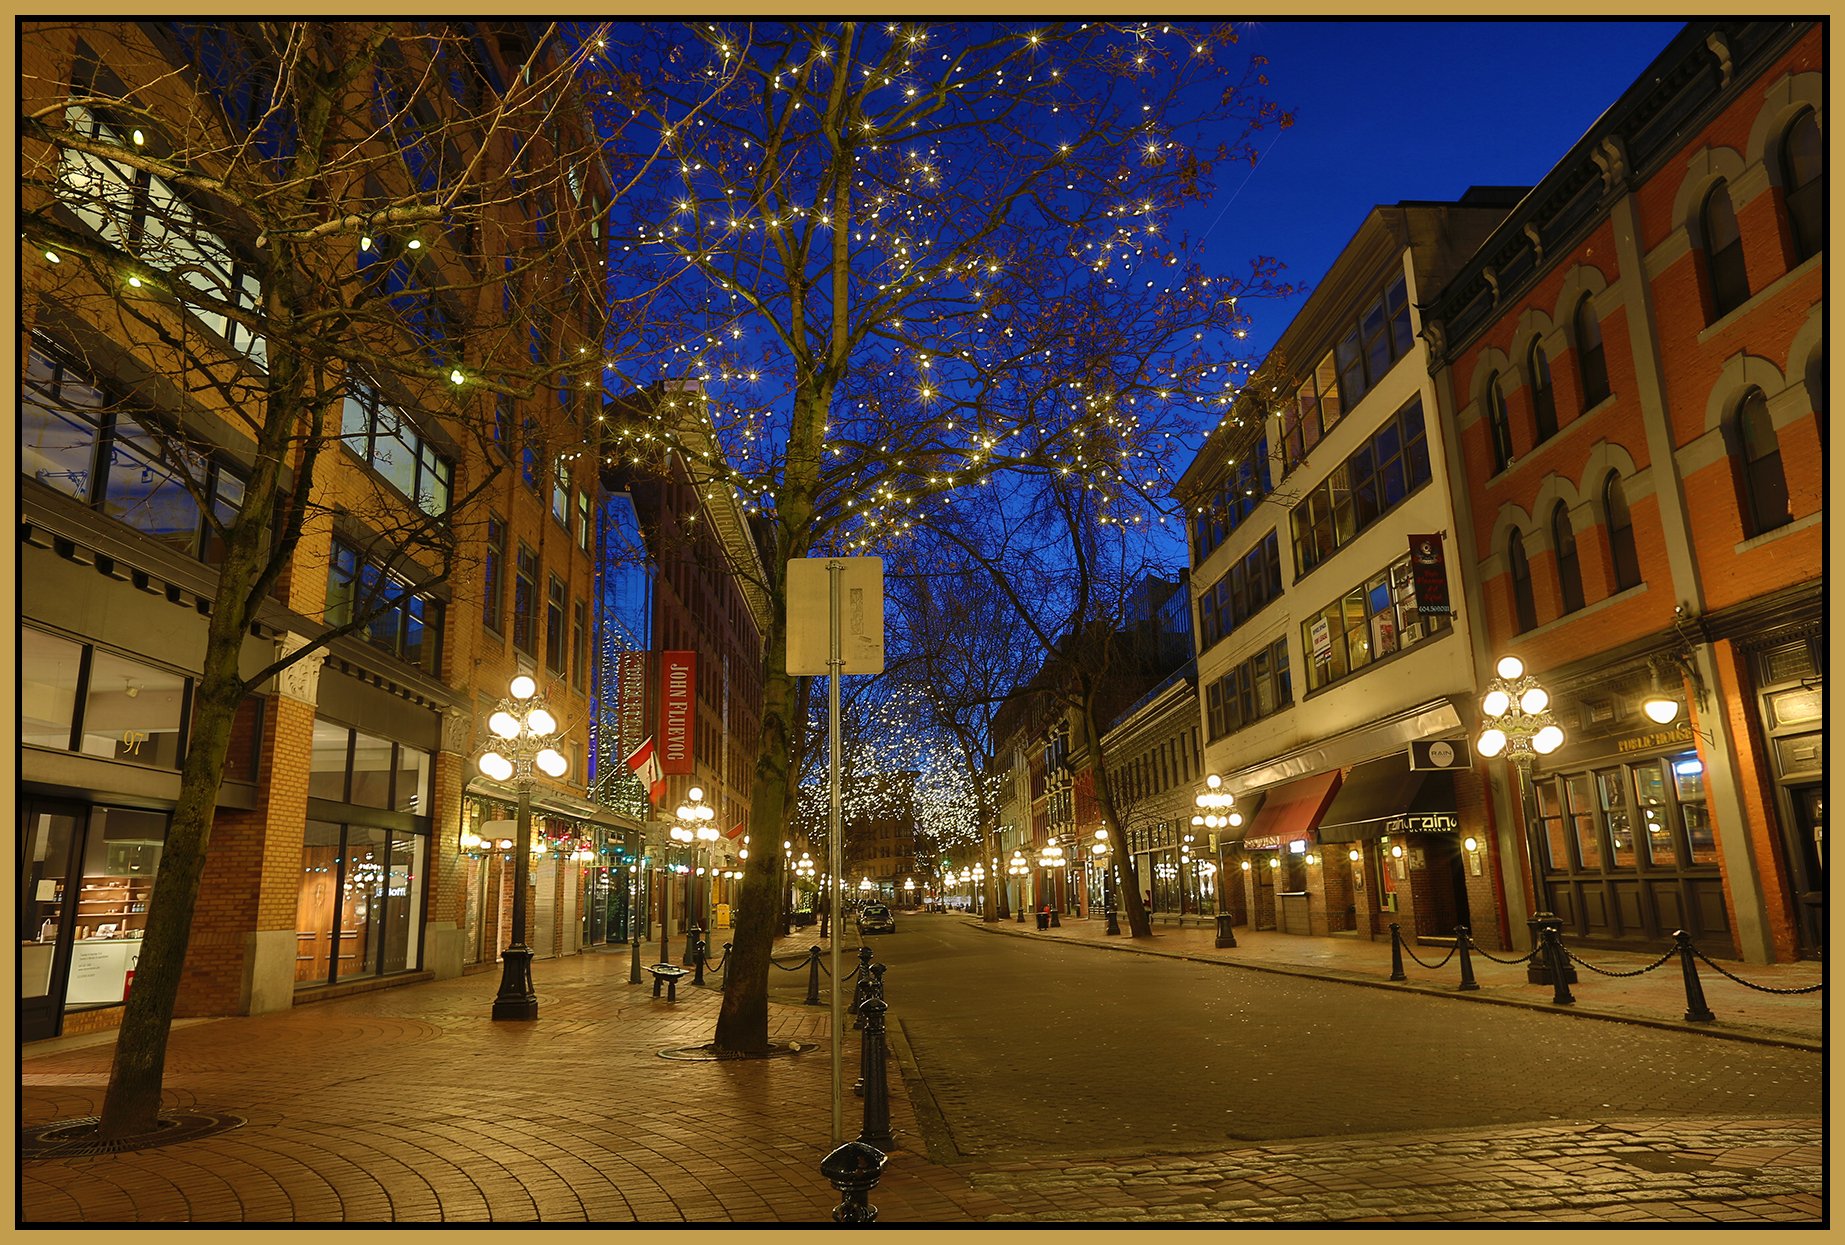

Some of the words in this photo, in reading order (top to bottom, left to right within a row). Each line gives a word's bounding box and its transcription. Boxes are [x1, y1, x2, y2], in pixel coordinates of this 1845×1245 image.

[669, 663, 689, 697] JOHN
[123, 729, 145, 756] 97
[667, 701, 688, 760] FLUEVOG
[1617, 734, 1655, 752] PUBLIC
